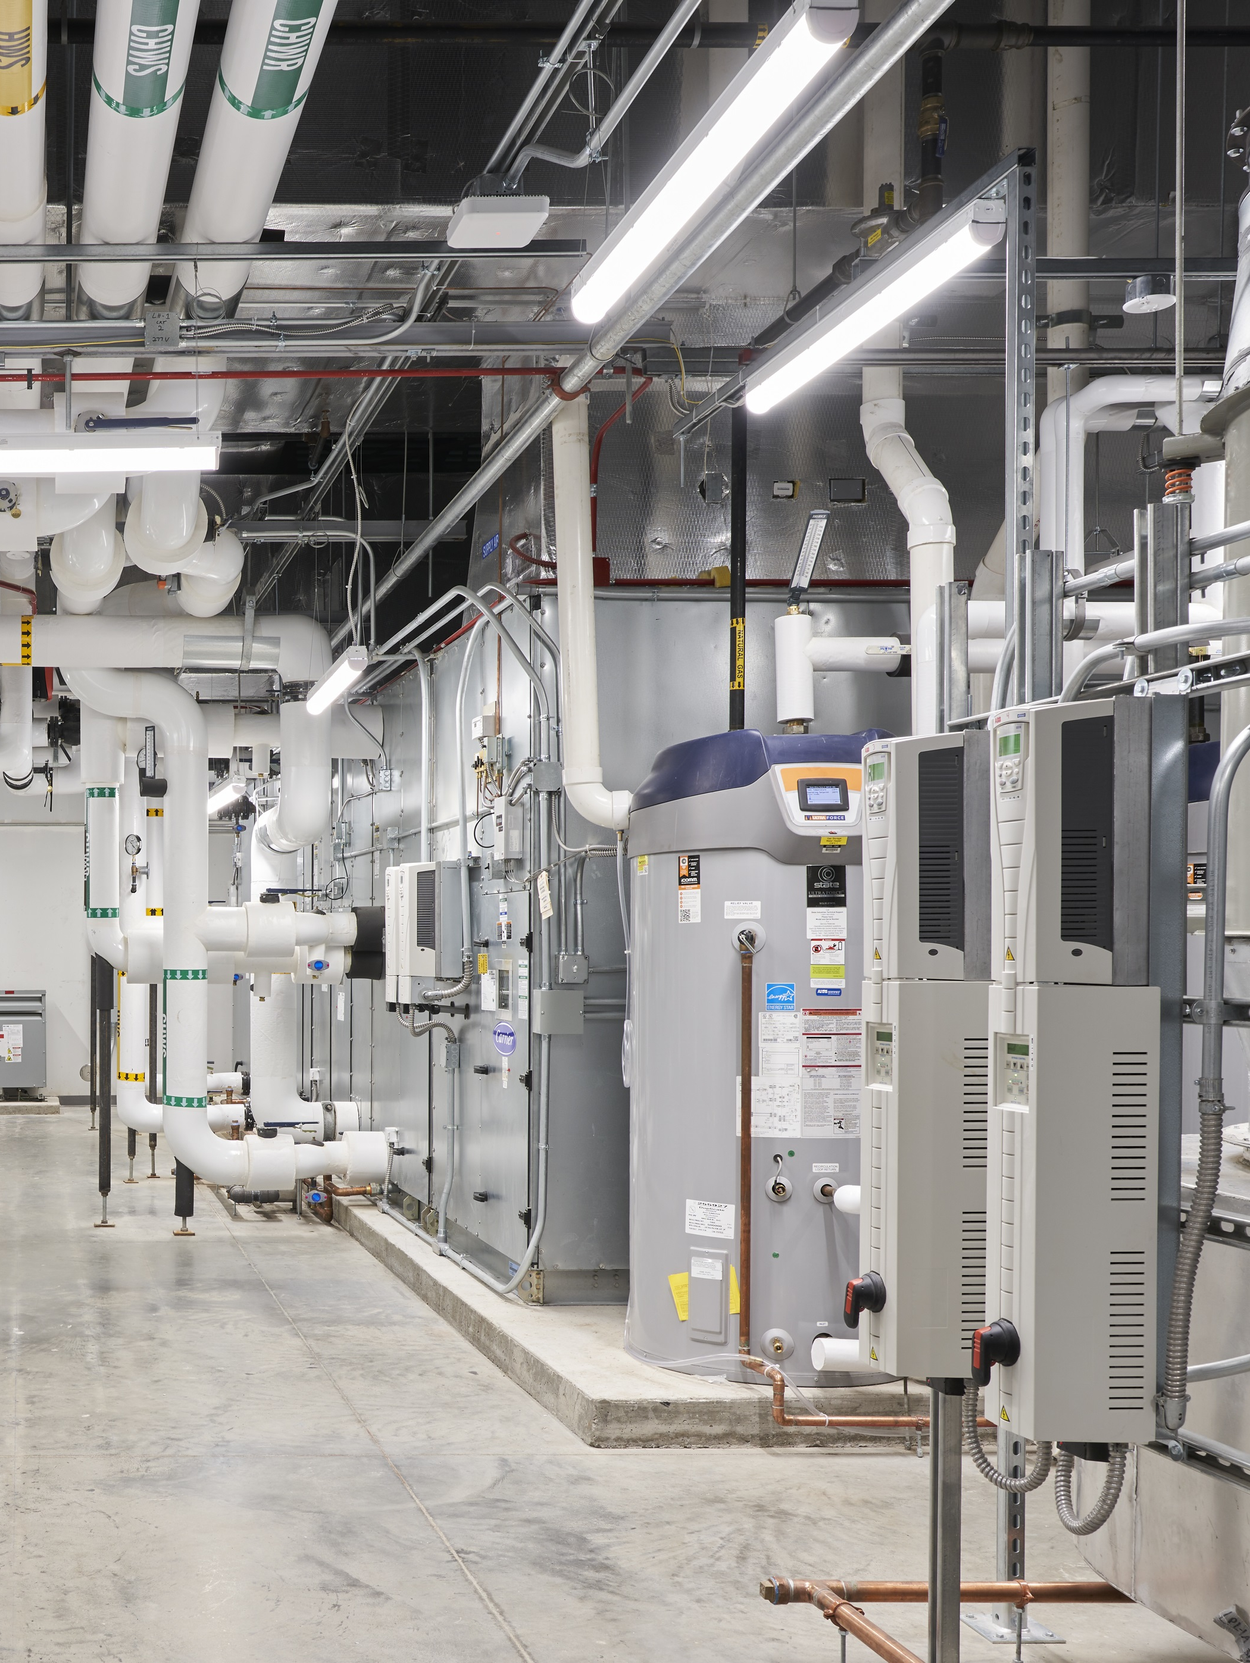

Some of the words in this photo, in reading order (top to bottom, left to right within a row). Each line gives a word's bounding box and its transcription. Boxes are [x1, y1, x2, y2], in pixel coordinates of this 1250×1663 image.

[127, 24, 174, 77] CHWS
[263, 17, 317, 72] CHWR
[814, 881, 840, 889] state
